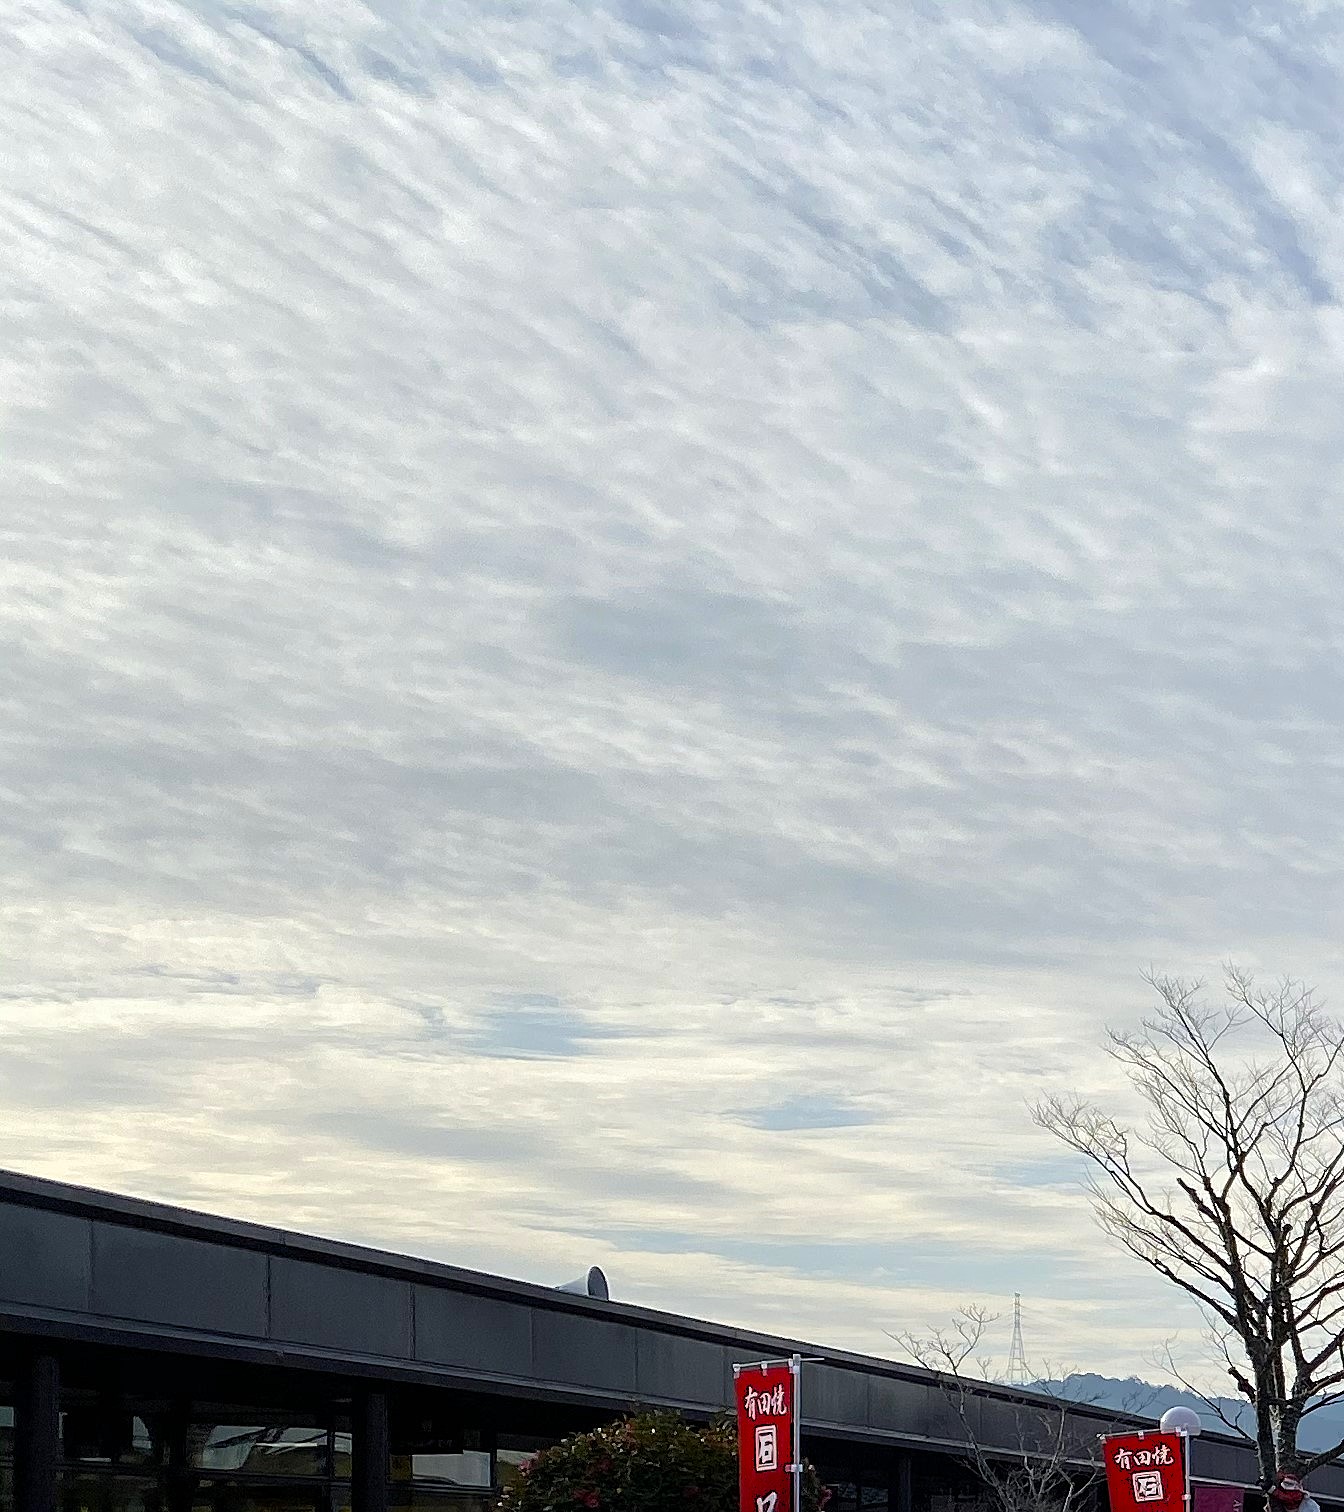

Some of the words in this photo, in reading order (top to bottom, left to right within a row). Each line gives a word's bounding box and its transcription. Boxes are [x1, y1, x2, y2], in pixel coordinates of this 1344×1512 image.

[745, 1384, 787, 1421] 有田焼
[1114, 1444, 1174, 1470] 有田焼
